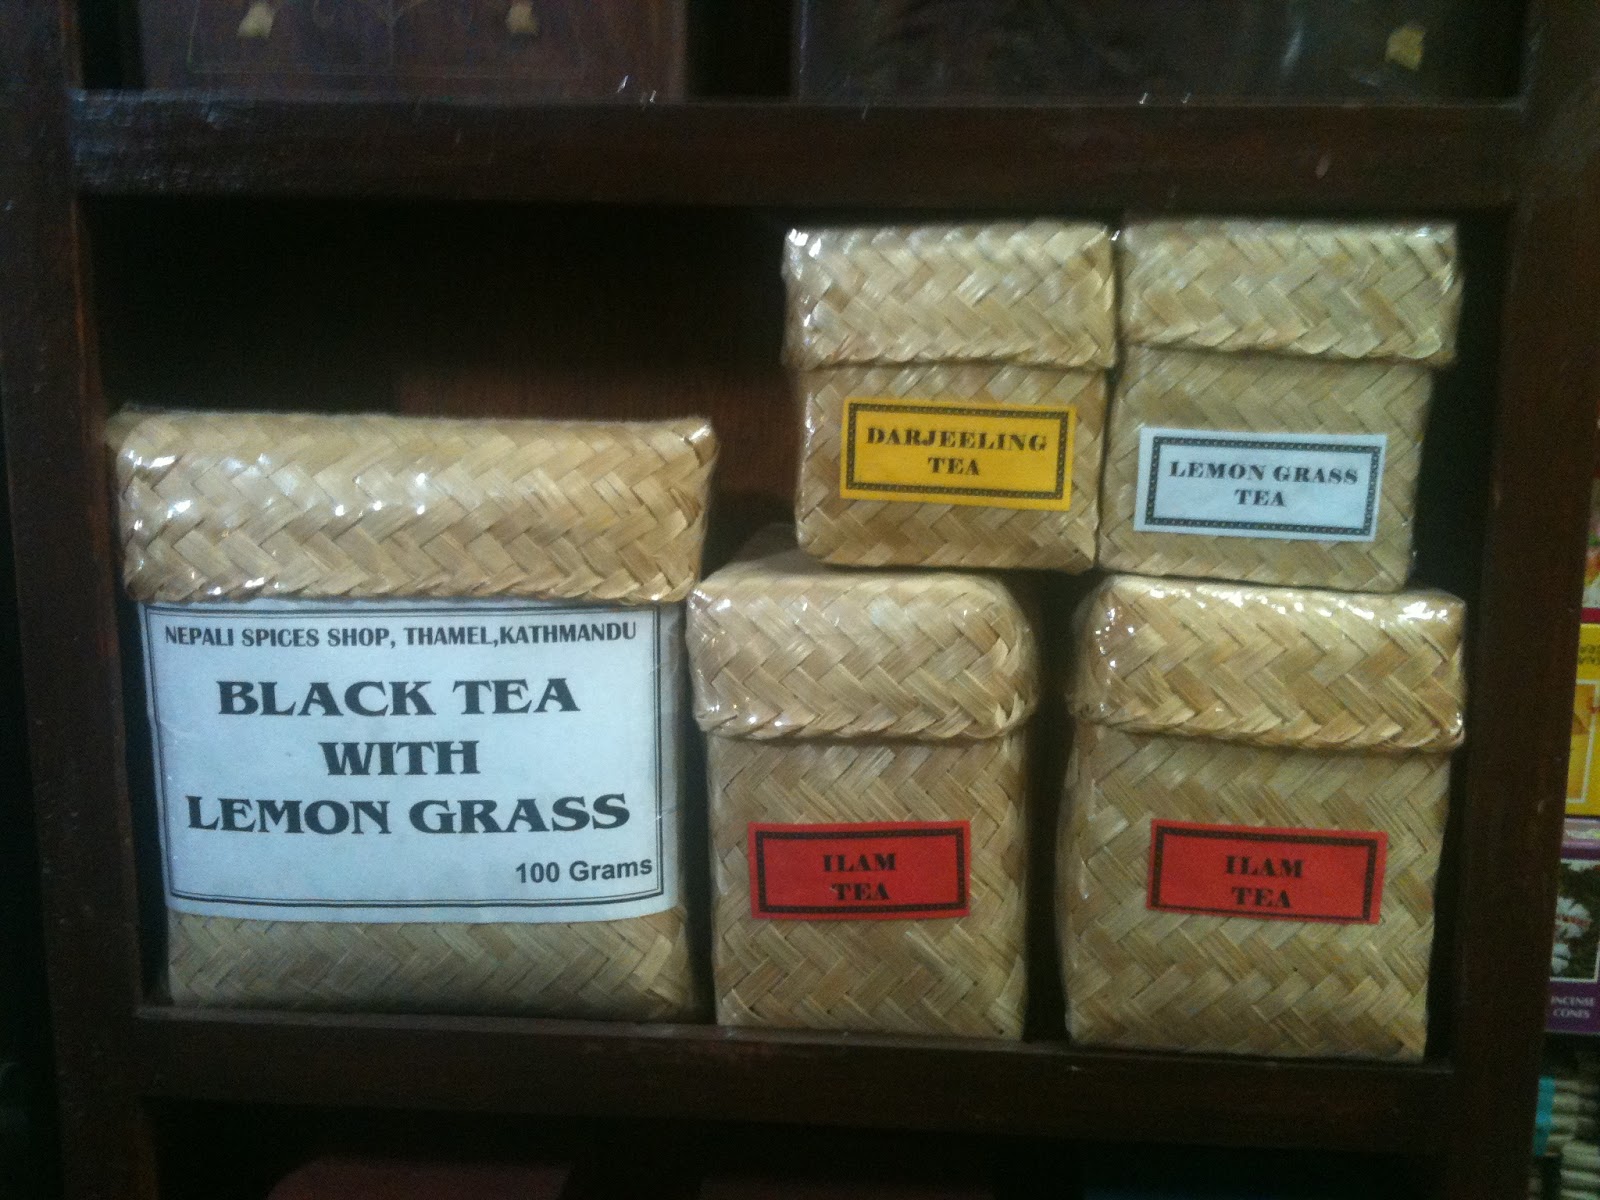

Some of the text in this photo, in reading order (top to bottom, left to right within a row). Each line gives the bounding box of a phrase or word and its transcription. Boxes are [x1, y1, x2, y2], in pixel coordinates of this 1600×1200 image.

[867, 427, 1046, 452] DARJEELING
[927, 457, 980, 476] TEA
[1169, 462, 1358, 485] LEMON GRASS
[1235, 489, 1286, 506] TEA
[165, 625, 234, 646] NEPALI
[242, 628, 320, 647] SPICES
[328, 627, 397, 648] SHOP,
[216, 677, 580, 716] BLACK TEA
[319, 740, 481, 775] WITH
[185, 793, 631, 835] LEMON GRASS
[515, 858, 653, 883] 100 Grams
[823, 853, 896, 873] ILAM
[1226, 856, 1304, 878] ILAM
[830, 882, 890, 901] TEA
[1231, 887, 1291, 909] TEA
